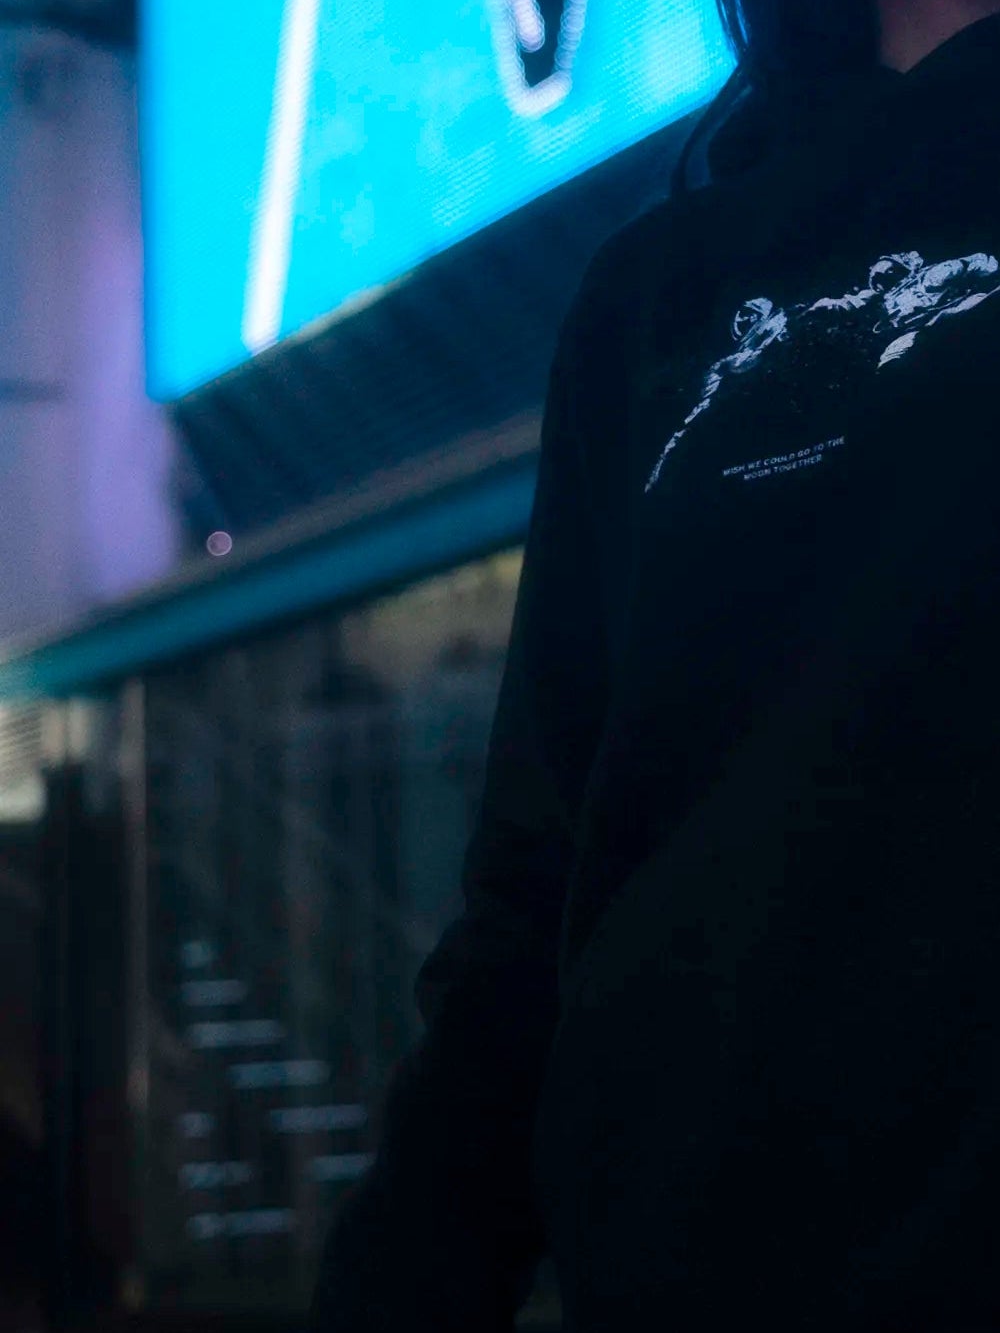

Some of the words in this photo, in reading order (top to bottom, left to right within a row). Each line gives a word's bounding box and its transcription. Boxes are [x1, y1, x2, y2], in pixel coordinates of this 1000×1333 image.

[722, 465, 746, 477] WISH
[747, 459, 761, 470] WE
[763, 452, 796, 466] COULD
[797, 447, 811, 458] GO
[813, 442, 825, 452] TO
[826, 435, 846, 448] THE
[743, 468, 772, 481] MOON
[773, 453, 822, 473] TOGETHER
